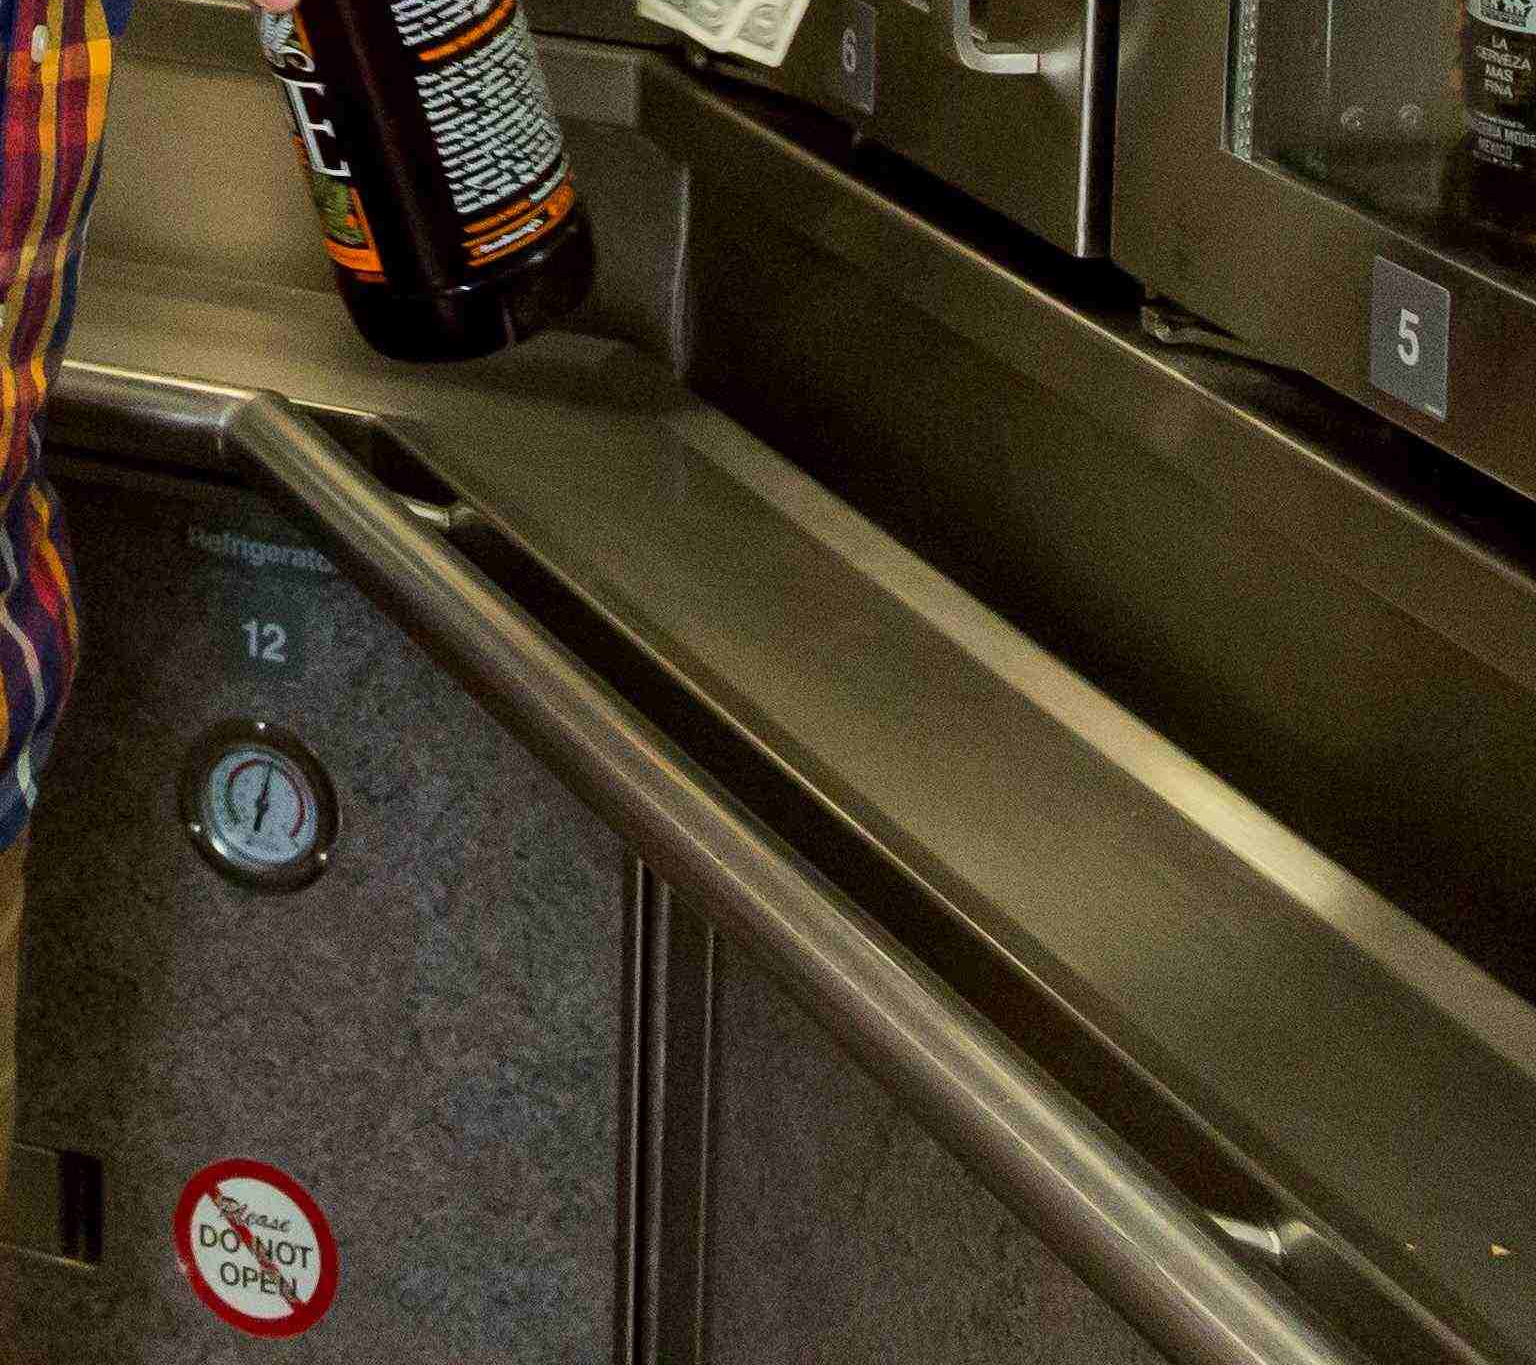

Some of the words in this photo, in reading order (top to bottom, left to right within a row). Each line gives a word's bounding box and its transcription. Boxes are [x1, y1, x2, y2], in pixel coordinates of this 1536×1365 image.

[840, 27, 858, 73] 6
[1395, 306, 1422, 367] 5
[189, 529, 335, 573] Refrigerato
[242, 620, 289, 663] 12
[217, 1195, 291, 1233] Please
[199, 1224, 241, 1254] DO
[253, 1234, 314, 1270] NOT
[219, 1260, 298, 1303] OPEN
